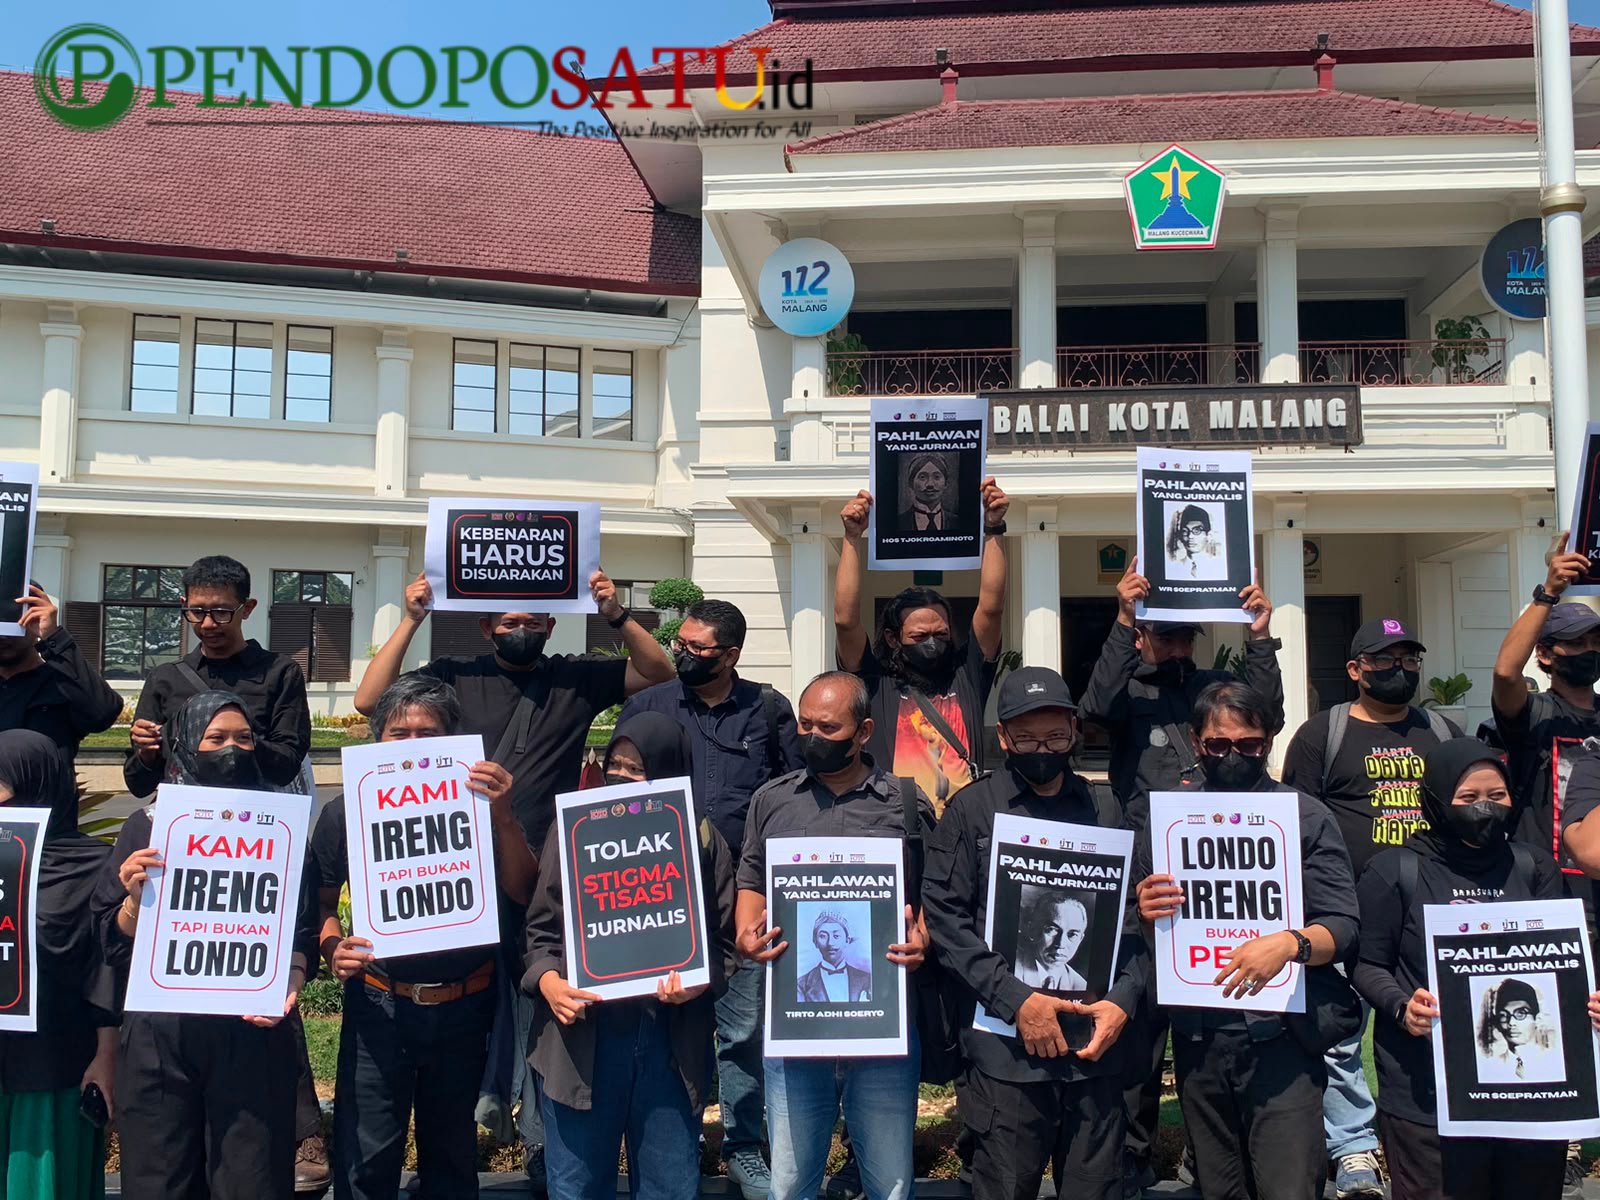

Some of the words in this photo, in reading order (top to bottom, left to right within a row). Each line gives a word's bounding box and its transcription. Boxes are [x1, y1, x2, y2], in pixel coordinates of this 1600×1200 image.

[781, 260, 830, 297] 112
[1506, 287, 1546, 295] MALAN
[782, 304, 828, 313] MALANG
[993, 403, 1089, 434] BALAI
[1108, 401, 1190, 431] KOTA
[1209, 398, 1347, 430] MALANG
[877, 430, 980, 441] PAHLAWAN
[885, 443, 917, 451] YANG
[919, 442, 977, 450] JURNALIS
[1144, 479, 1245, 491] PAHLAWAN
[460, 527, 565, 541] KEBENARAN
[900, 535, 974, 543] TJOKROAMINOTO
[461, 543, 565, 566] HARUS
[461, 568, 563, 581] DISUARAKAN
[1372, 747, 1414, 756] HARTA
[1364, 755, 1424, 778] DATA
[377, 779, 459, 810] KAMI
[186, 834, 275, 860] KAMI
[371, 811, 472, 863] IRENG
[584, 831, 673, 863] TOLAK
[1181, 836, 1276, 870] LONDO
[378, 868, 412, 882] TAPI
[417, 860, 471, 878] BUKAN
[583, 861, 681, 894] STIGMA
[1000, 854, 1121, 879] PAHLAWAN
[169, 868, 279, 914] IRENG
[774, 875, 894, 888] PAHLAWAN
[1007, 871, 1047, 884] YANG
[1048, 876, 1117, 891] JURNALIS
[380, 877, 474, 923] LONDO
[593, 882, 673, 911] TISASI
[782, 891, 820, 899] YANG
[822, 890, 892, 899] JURNALIS
[1179, 879, 1283, 921] IRENG
[171, 921, 207, 933] TAPI
[212, 923, 270, 935] BUKAN
[587, 908, 686, 938] JURNALIS
[1206, 928, 1260, 939] BUKAN
[165, 939, 268, 978] LONDO
[1189, 945, 1233, 969] PE
[1438, 941, 1580, 961] PAHLAWAN
[1450, 964, 1496, 974] YANG
[1497, 959, 1579, 972] JURNALIS
[1491, 1090, 1578, 1099] SOEPRATMAN
